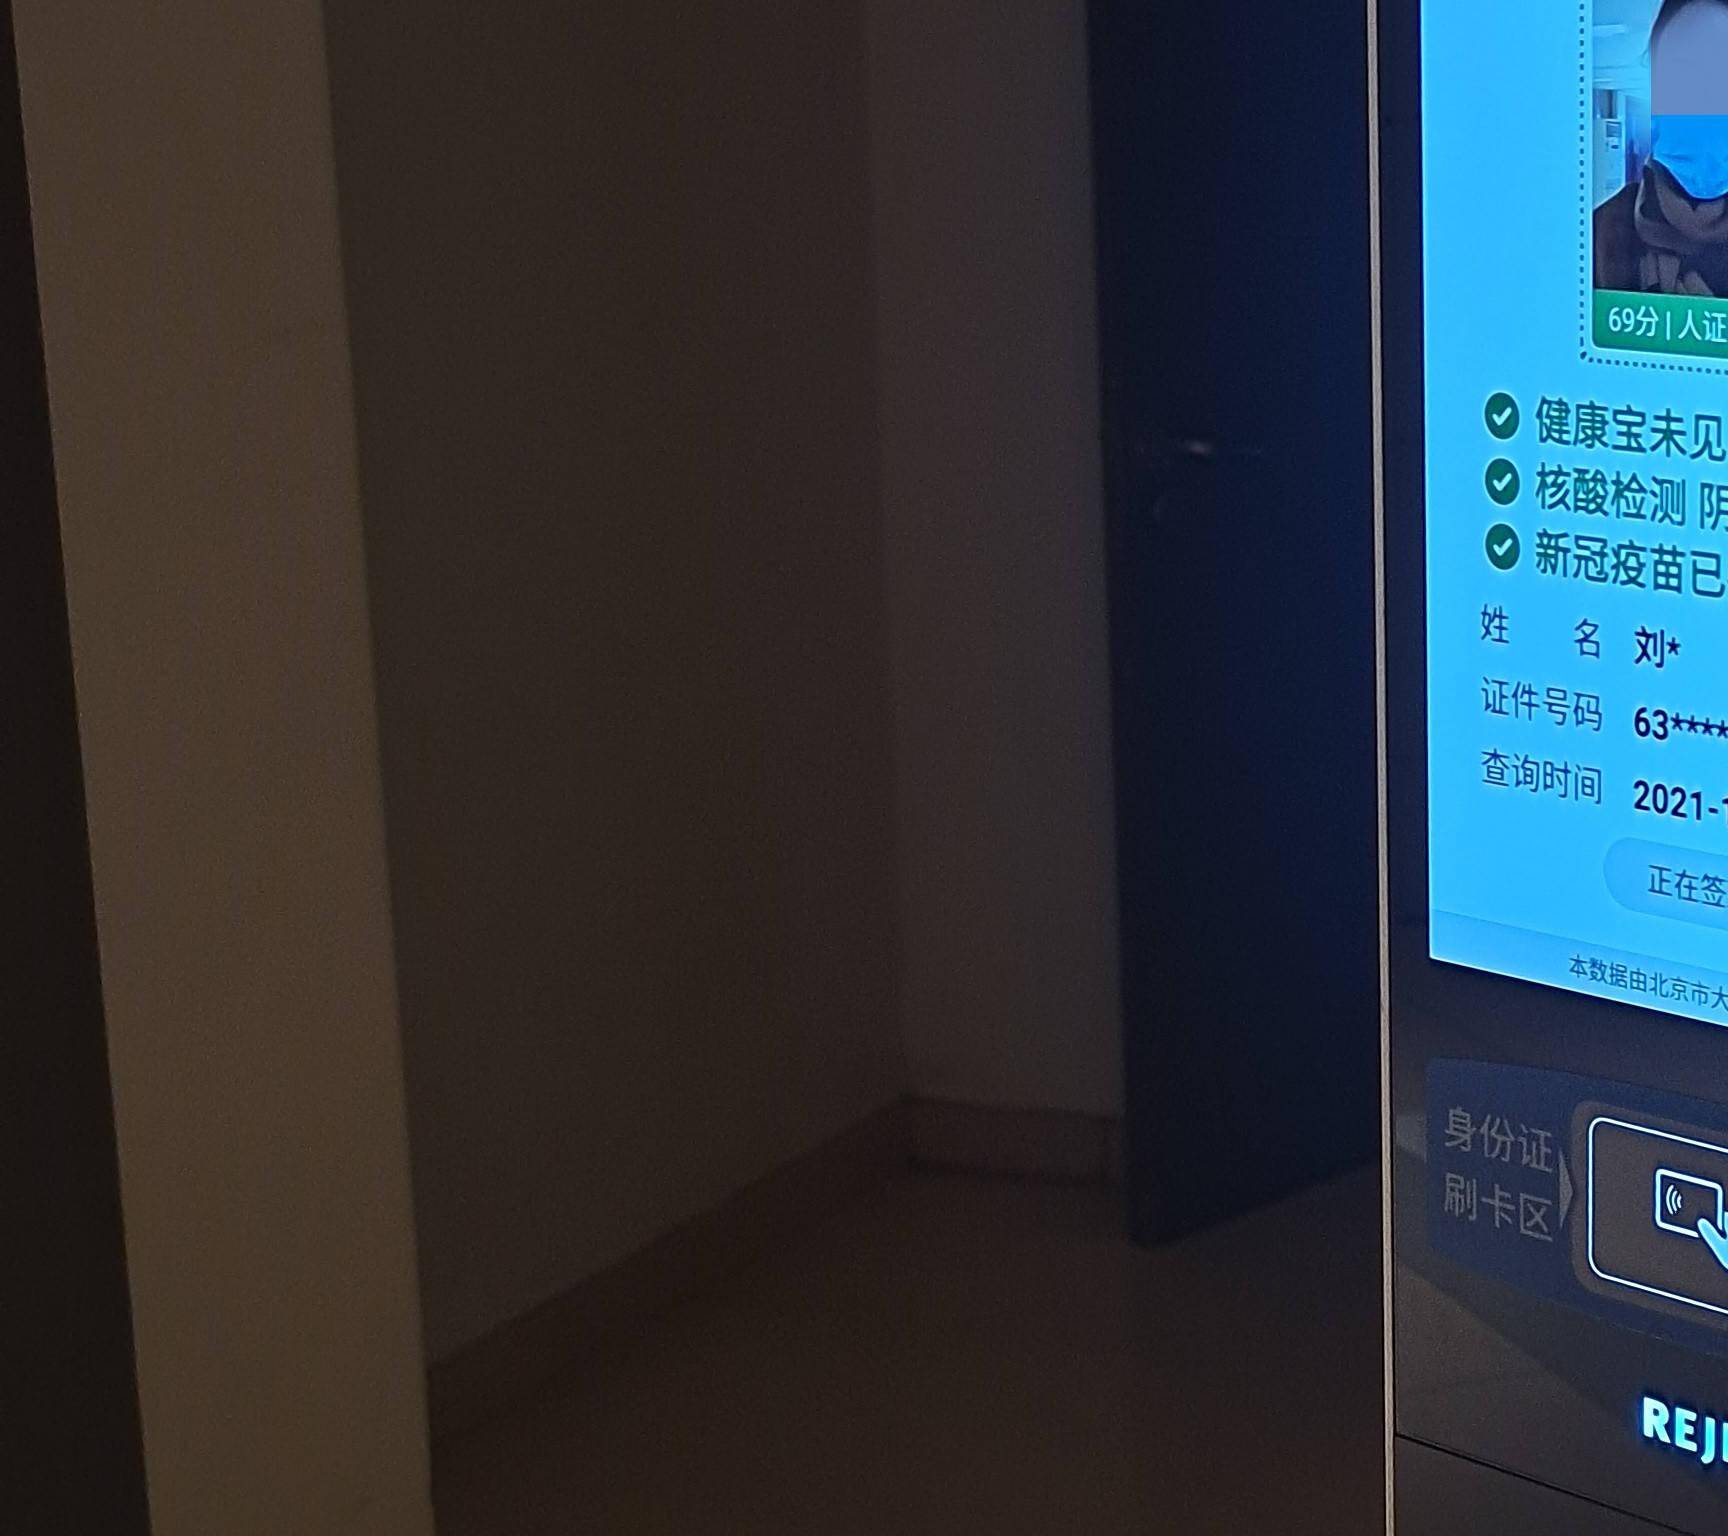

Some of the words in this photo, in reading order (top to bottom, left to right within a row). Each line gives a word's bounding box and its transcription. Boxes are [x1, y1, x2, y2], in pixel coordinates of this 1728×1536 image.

[1607, 305, 1659, 338] 69分
[1534, 461, 1688, 527] 核酸检测
[1480, 602, 1510, 644] 姓
[1573, 617, 1601, 659] 名
[1480, 675, 1603, 732] 证件号码
[1480, 747, 1603, 805] 查询时间
[1443, 1106, 1554, 1175] 身份证
[1443, 1172, 1554, 1242] 刷卡区
